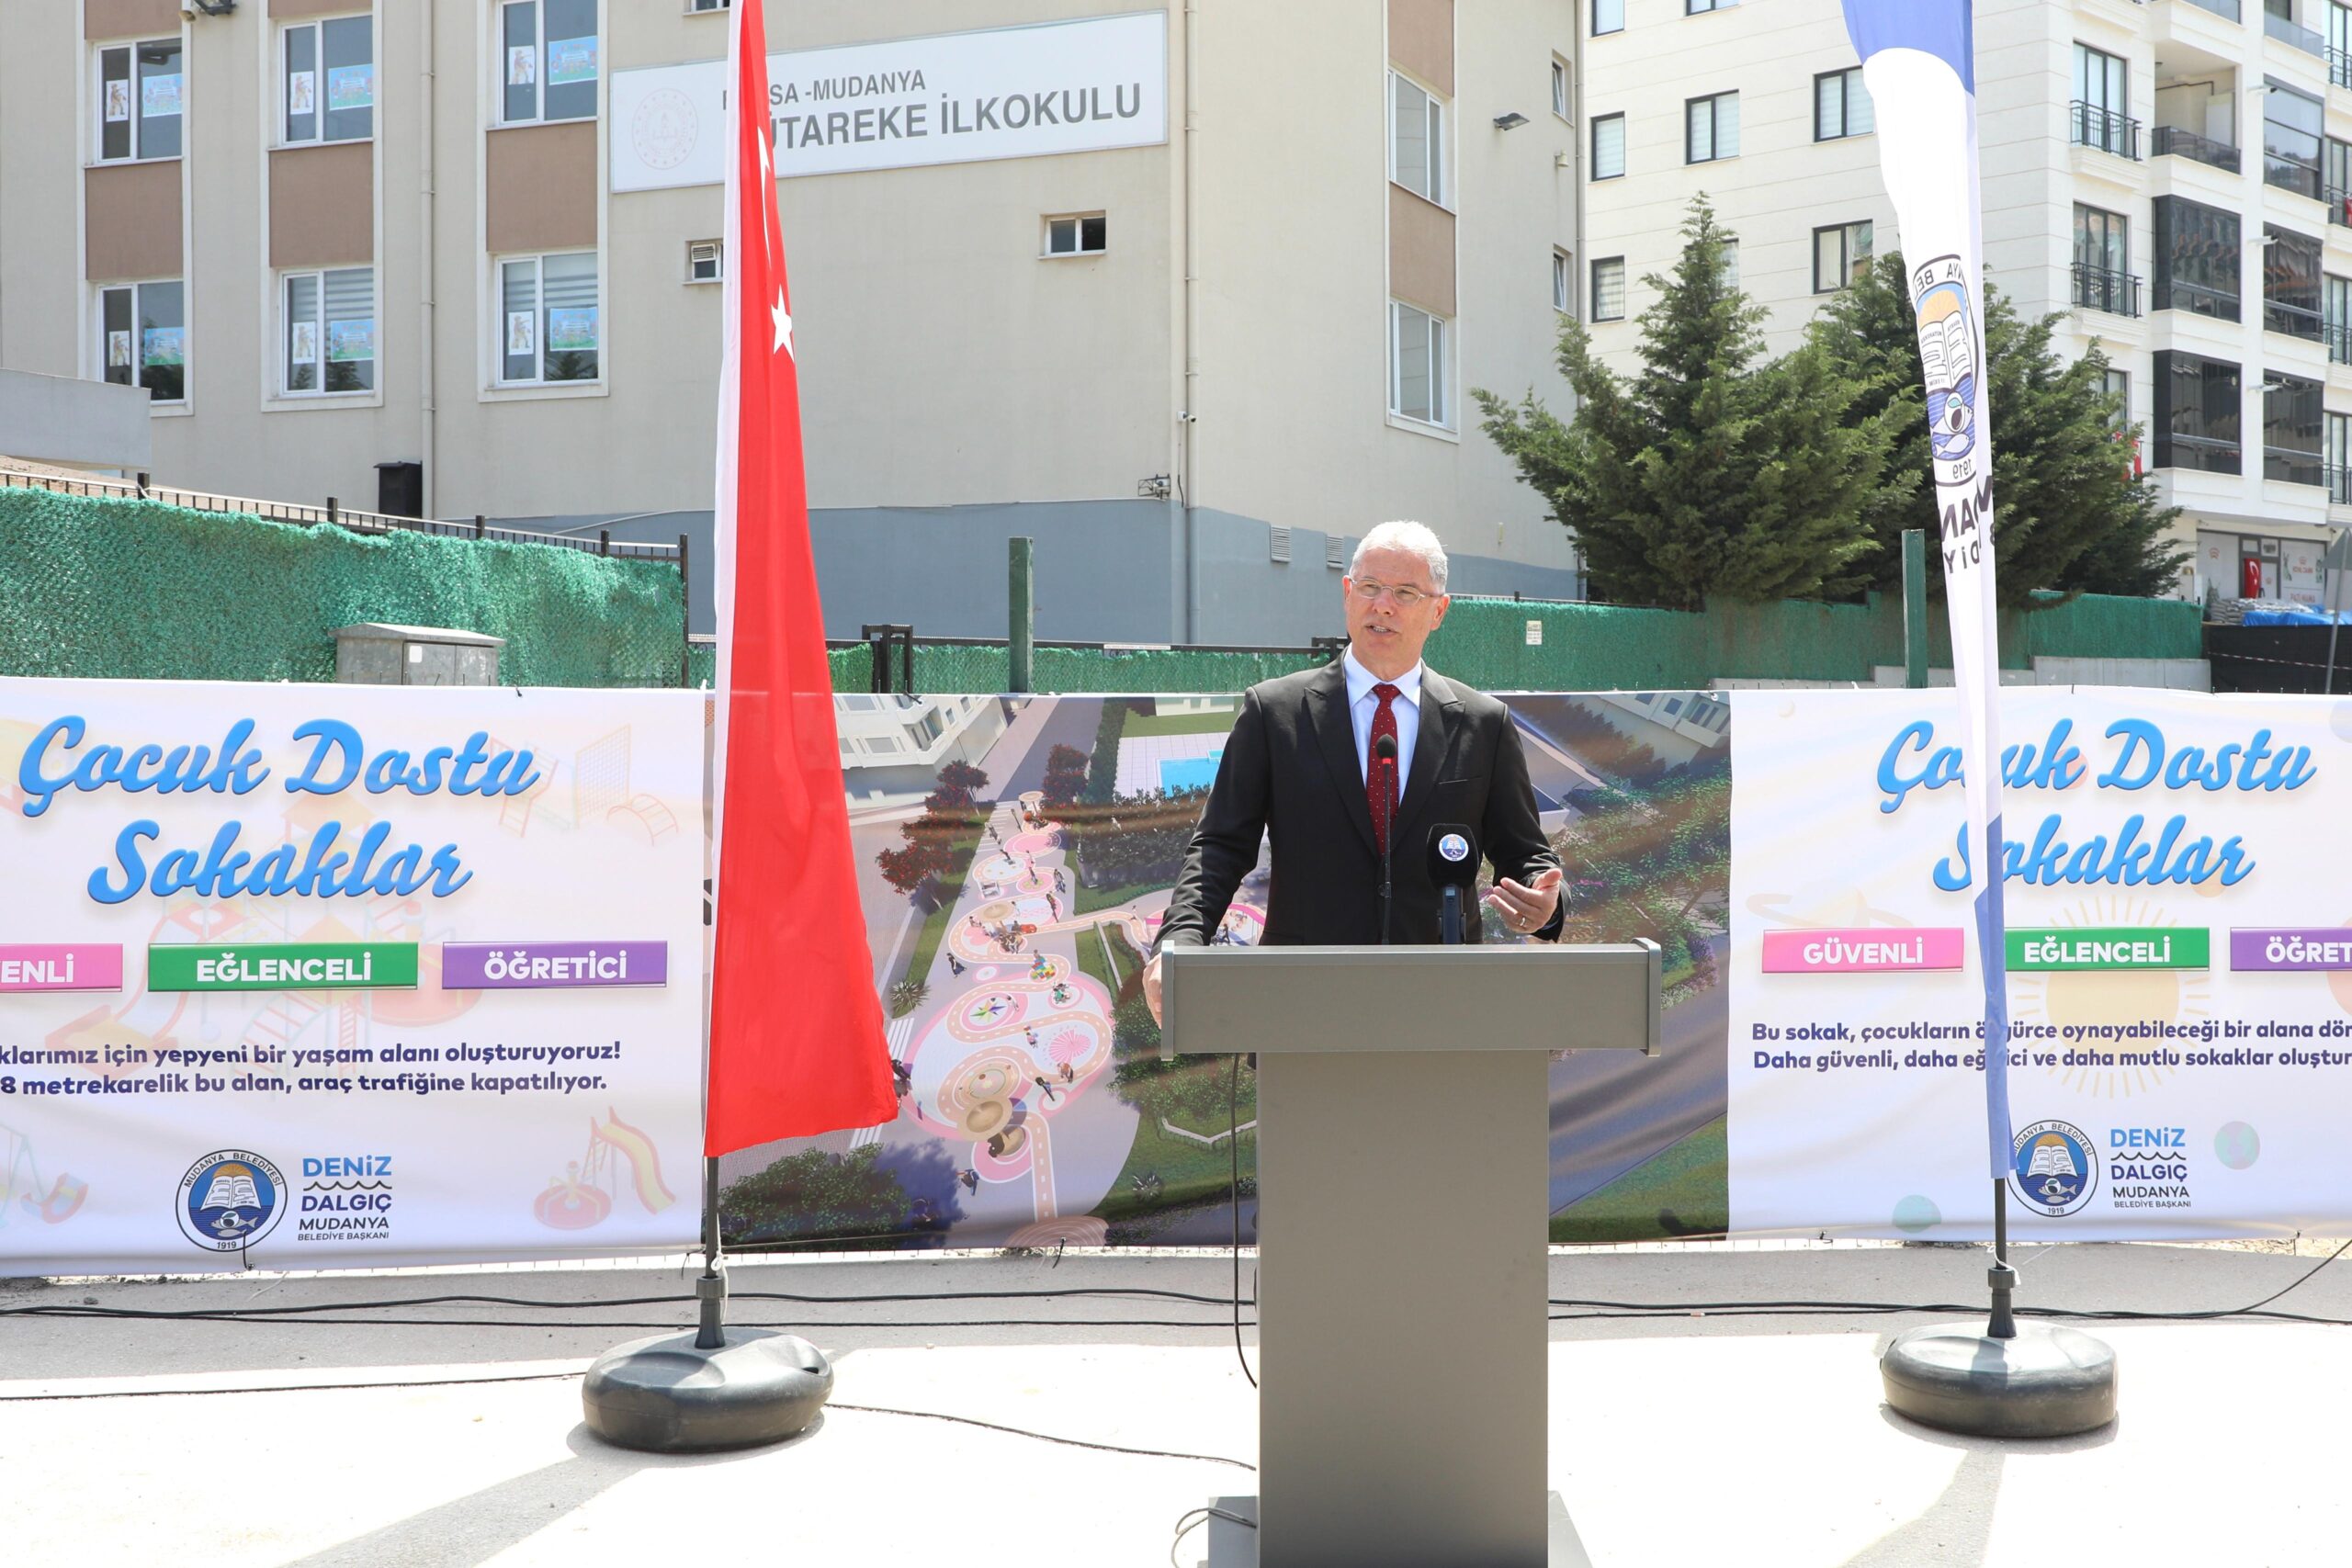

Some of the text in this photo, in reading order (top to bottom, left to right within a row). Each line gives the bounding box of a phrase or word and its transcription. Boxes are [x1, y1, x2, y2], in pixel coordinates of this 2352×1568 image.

[770, 83, 1142, 149] TAREKE İLKOKULU
[18, 715, 541, 817] Çocuk Dostu
[1877, 717, 2317, 814] Çouk Dostu
[86, 818, 473, 905] Sokaklar
[1803, 935, 1925, 964] GÜVENLİ
[2024, 935, 2171, 963] EĞLENCELİ
[0, 953, 74, 983] ENLİ
[197, 952, 372, 982] EĞLENCELİ
[484, 950, 628, 980] ÖĞRETİCİ
[1752, 1023, 1780, 1041] Bu
[1785, 1022, 1856, 1043] sokak,
[1860, 1021, 1970, 1043] çocukların
[1975, 1021, 2057, 1043] öürce
[2062, 1020, 2219, 1043] oynayabileceği
[2224, 1020, 2251, 1038] bir
[2256, 1020, 2313, 1038] alana
[105, 1043, 148, 1067] için
[153, 1044, 247, 1067] yepyeni
[254, 1044, 287, 1064] bir
[292, 1048, 373, 1067] yaşam
[379, 1043, 439, 1063] alanı
[446, 1041, 621, 1066] oluşturuyoruz!
[1754, 1051, 1812, 1069] Daha
[1816, 1050, 1899, 1072] güvenli,
[1905, 1050, 1958, 1067] daha
[2032, 1053, 2057, 1066] ve
[2062, 1048, 2114, 1066] daha
[2120, 1048, 2180, 1066] mutlu
[2186, 1047, 2273, 1066] sokaklar
[22, 1073, 188, 1095] metrekarelik
[195, 1073, 225, 1092] bu
[232, 1073, 292, 1094] alan,
[298, 1076, 353, 1094] araç
[358, 1073, 465, 1095] trafiğine
[471, 1071, 607, 1095] kapatılıyor.
[184, 1154, 225, 1188] MUDANYA
[2111, 1165, 2188, 1182] DALGIÇ
[301, 1193, 392, 1213] DALGIÇ
[2113, 1186, 2190, 1198] MUDANYA
[2114, 1200, 2154, 1208] BELEDİYE
[2047, 1206, 2065, 1215] 1919
[298, 1231, 345, 1241] BELEDİYE
[299, 1216, 390, 1231] MUDANYA
[216, 1241, 237, 1249] 1919
